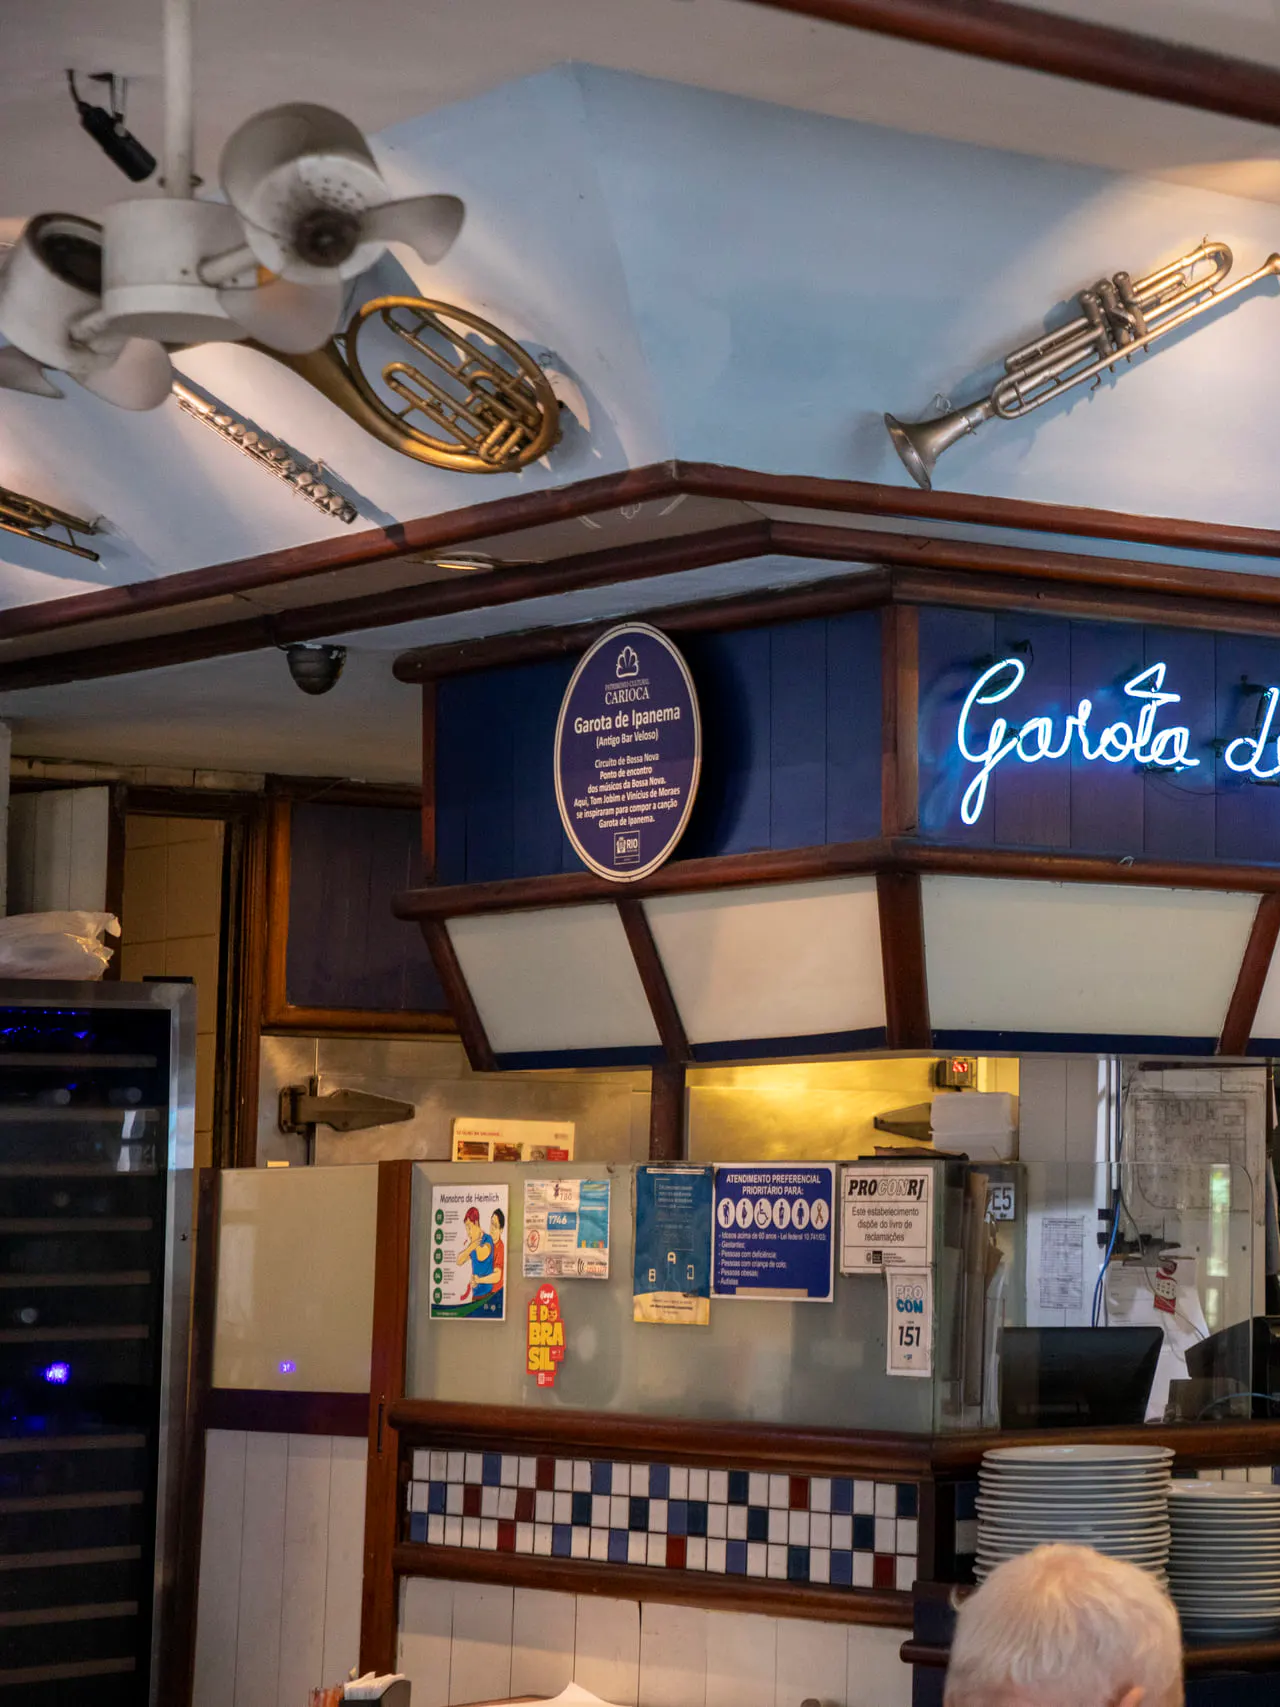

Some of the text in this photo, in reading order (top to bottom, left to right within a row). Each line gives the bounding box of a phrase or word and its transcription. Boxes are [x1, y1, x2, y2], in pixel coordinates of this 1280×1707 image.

[605, 686, 650, 705] CARIOCA
[574, 706, 681, 734] Garota de Ipanema
[596, 728, 659, 749] (Antigo Bar Veloso)
[957, 658, 1201, 825] Garota
[594, 753, 660, 769] Circuito de Bossa Nova
[600, 766, 653, 780] Ponto de encontro
[588, 784, 598, 794] dos
[622, 780, 631, 789] da
[632, 778, 648, 788] Bossa
[649, 776, 666, 786] Nova.
[590, 796, 602, 805] Tom
[604, 794, 620, 804] Jobim
[650, 788, 657, 798] de
[658, 787, 680, 797] Moraes
[576, 811, 584, 819] se
[584, 808, 615, 820] inspiraram
[616, 806, 628, 816] para
[629, 803, 652, 814] compor
[658, 798, 678, 812] canção
[598, 815, 656, 828] Garota de Ipanema.
[626, 838, 638, 849] RIO
[726, 1174, 820, 1184] ATENDIMENTO PREFERENCIAL
[742, 1184, 804, 1194] PRIORITÁRIO PARA:
[466, 1193, 472, 1202] de
[474, 1192, 500, 1202] Heimlich
[852, 1207, 919, 1216] Este estabelecimento
[548, 1215, 568, 1224] 1746
[858, 1220, 912, 1230] dispõe do livro de
[738, 1232, 750, 1240] acima
[752, 1232, 758, 1240] de
[766, 1232, 776, 1240] anos
[864, 1232, 904, 1242] reclamações
[896, 1285, 924, 1298] PRO
[896, 1299, 923, 1314] CON
[529, 1322, 564, 1346] BRA
[898, 1326, 920, 1346] 151
[528, 1346, 554, 1370] SIL
